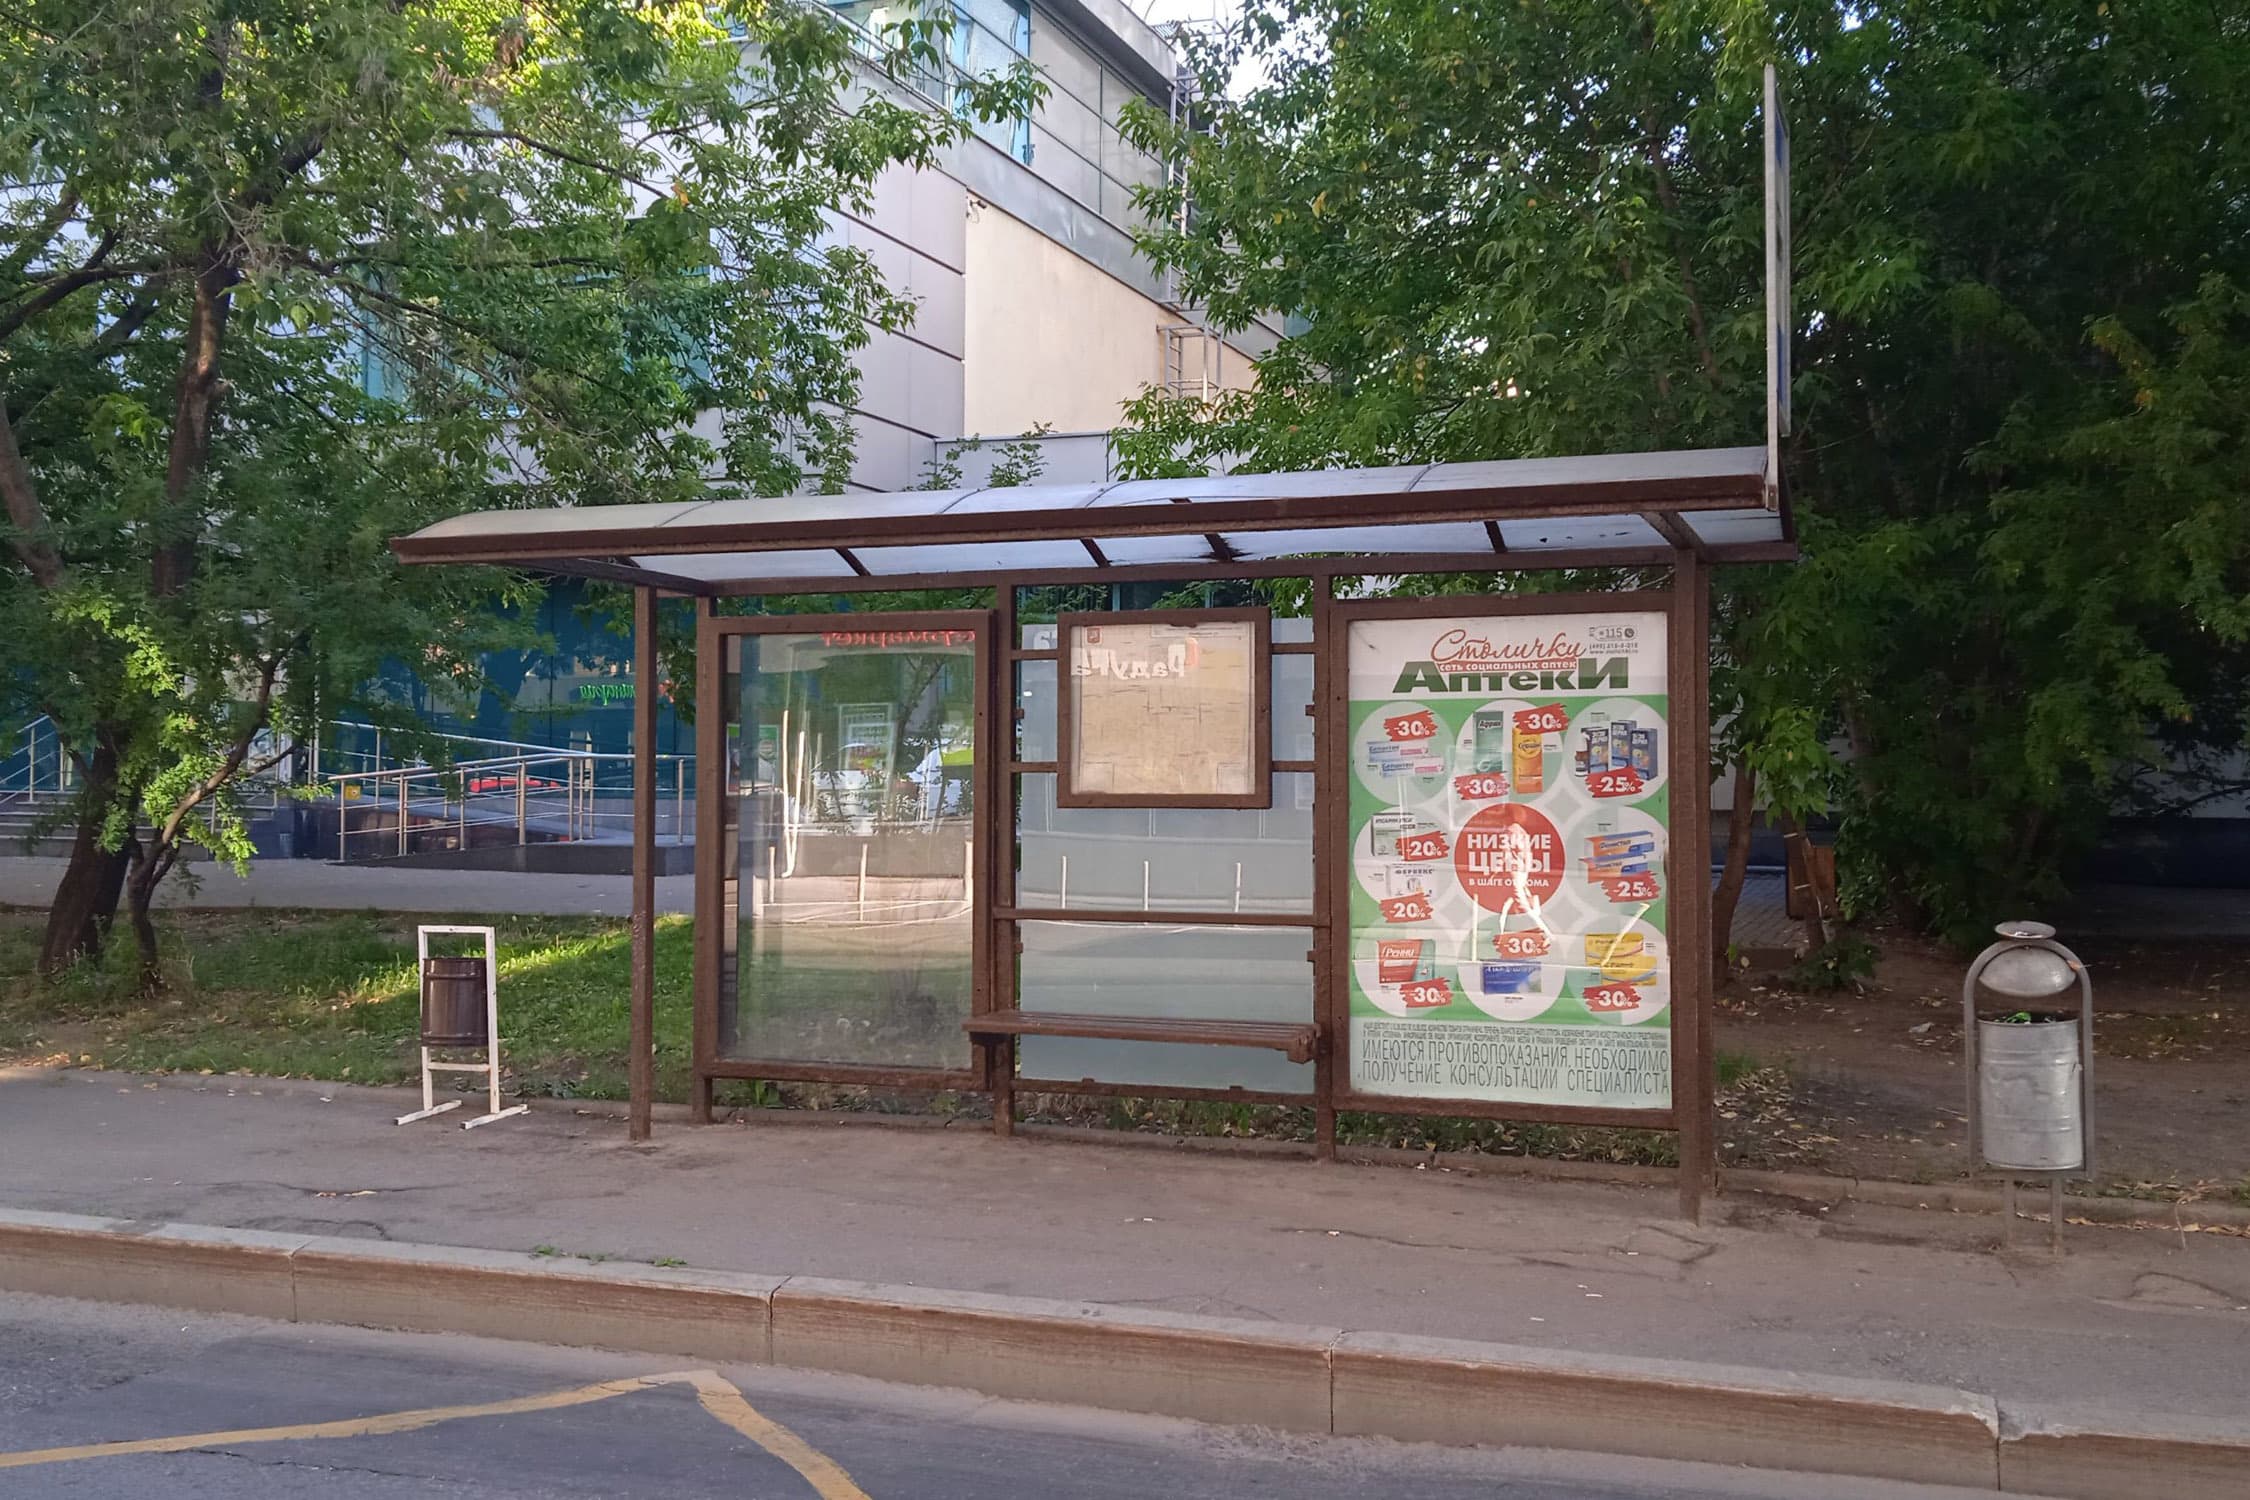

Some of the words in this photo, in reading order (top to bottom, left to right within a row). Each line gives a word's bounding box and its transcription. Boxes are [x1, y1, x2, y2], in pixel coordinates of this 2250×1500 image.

[1431, 629, 1587, 662] Столички
[1466, 662, 1538, 671] социальных
[1541, 660, 1577, 670] аптек
[1394, 720, 1430, 736] -30%
[1523, 713, 1562, 729] -30%
[1464, 779, 1508, 794] -30%
[1596, 776, 1636, 792] -25%
[1406, 840, 1442, 856] -20%
[1468, 851, 1550, 875] ЦЕНЫ
[1469, 878, 1475, 886] В
[1613, 881, 1653, 897] -25%
[1389, 902, 1425, 918] -20%
[1385, 947, 1415, 957] Ренни
[1503, 937, 1542, 954] -30%
[1409, 987, 1446, 1003] -30%
[1594, 990, 1632, 1007] -30%
[1362, 1039, 1424, 1062] ИМЕЮТСЯ
[1429, 1041, 1571, 1068] ПРОТИВОПОКАЗАНИЯ.
[1575, 1047, 1669, 1074] НЕОБХОДИМО
[1362, 1060, 1441, 1084] ПОЛУЧЕНИЕ
[1450, 1064, 1558, 1091] КОНСУЛЬТАЦИИ
[1567, 1068, 1669, 1095] СПЕЦИАЛИСТА
